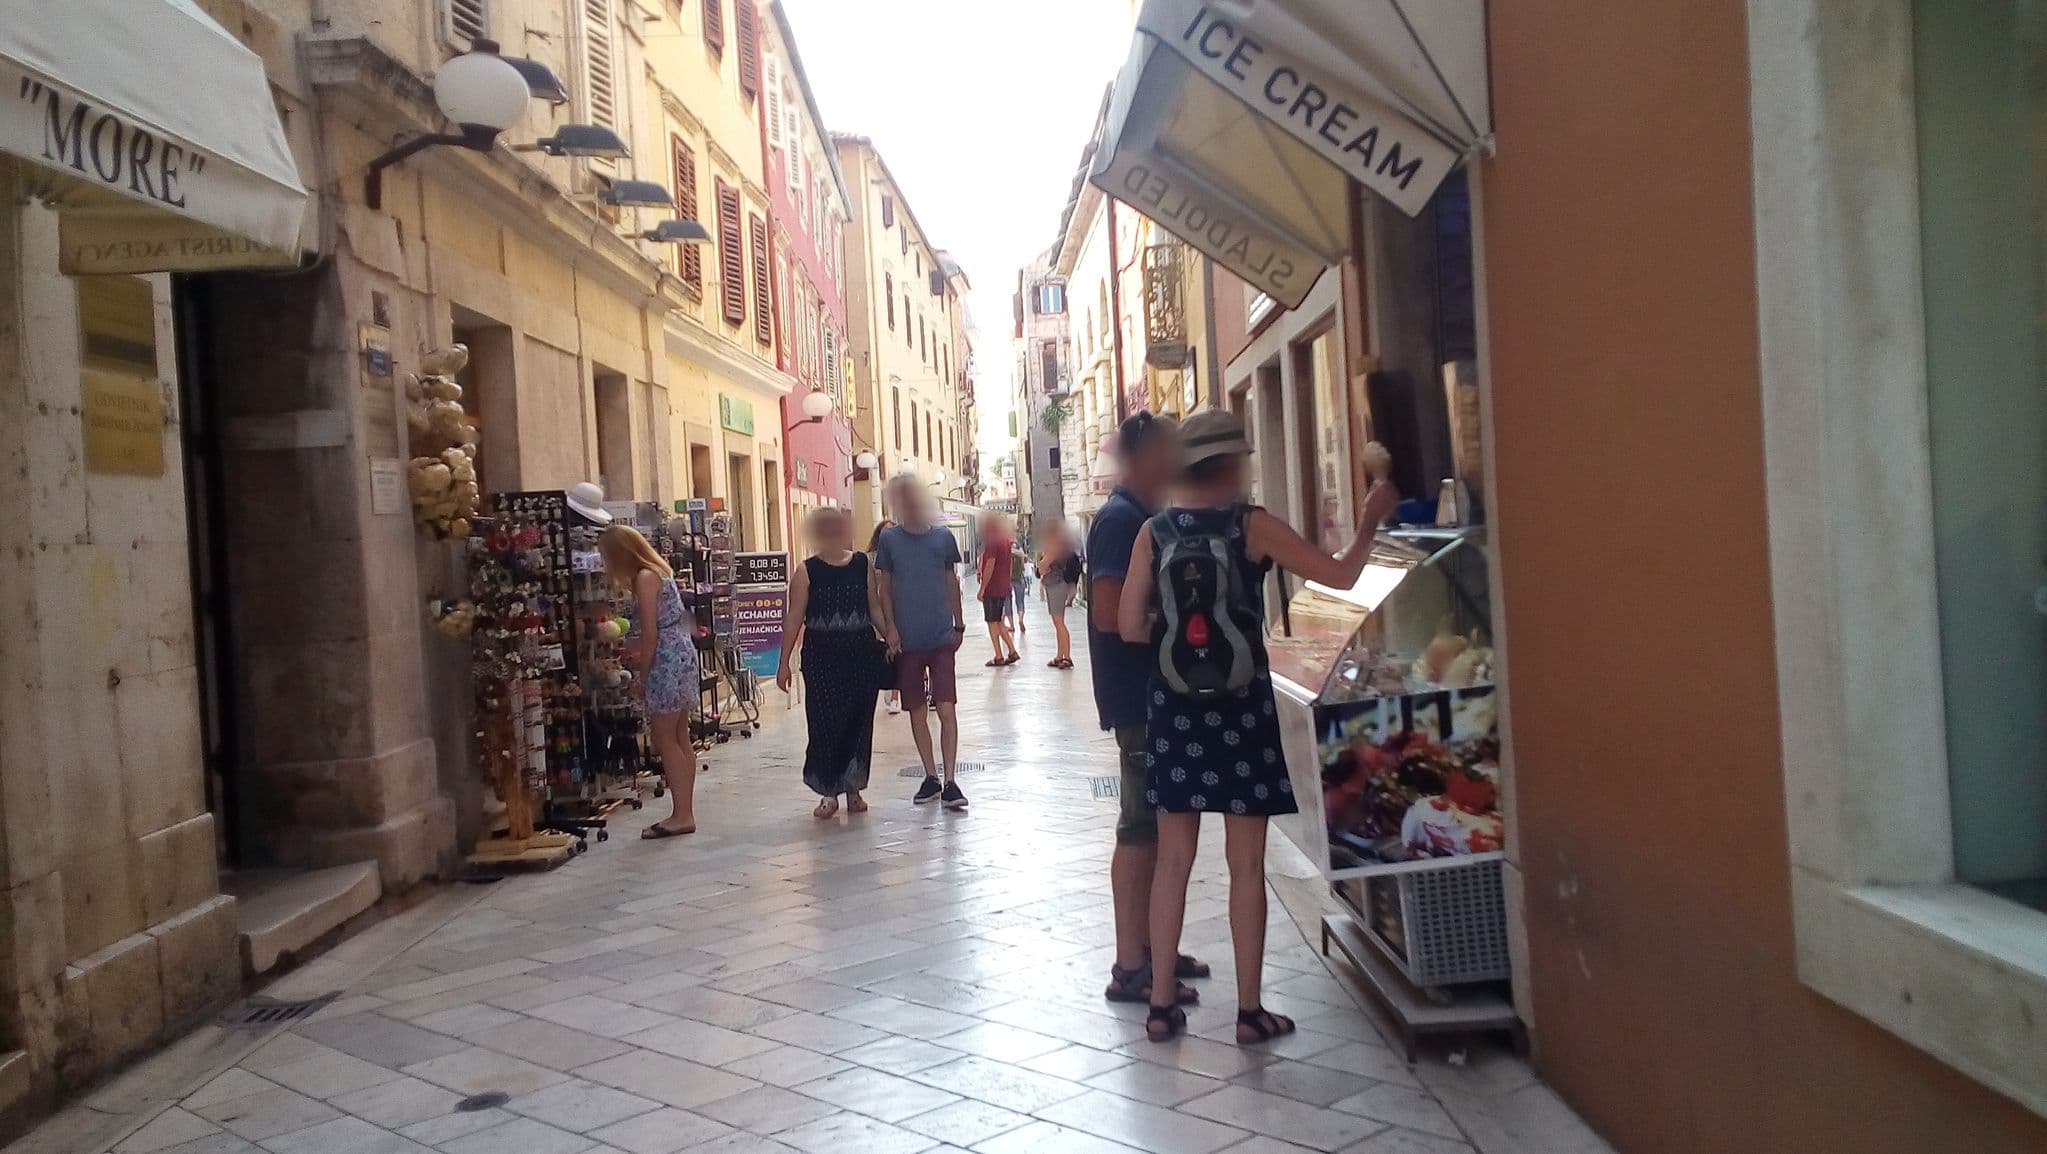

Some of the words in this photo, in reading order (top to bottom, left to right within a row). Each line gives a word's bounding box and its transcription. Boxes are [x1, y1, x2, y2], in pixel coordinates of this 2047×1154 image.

[20, 75, 206, 209] "MORE"
[1183, 8, 1264, 81] ICE
[1263, 67, 1424, 191] CREAM
[735, 609, 783, 620] XCHANGE
